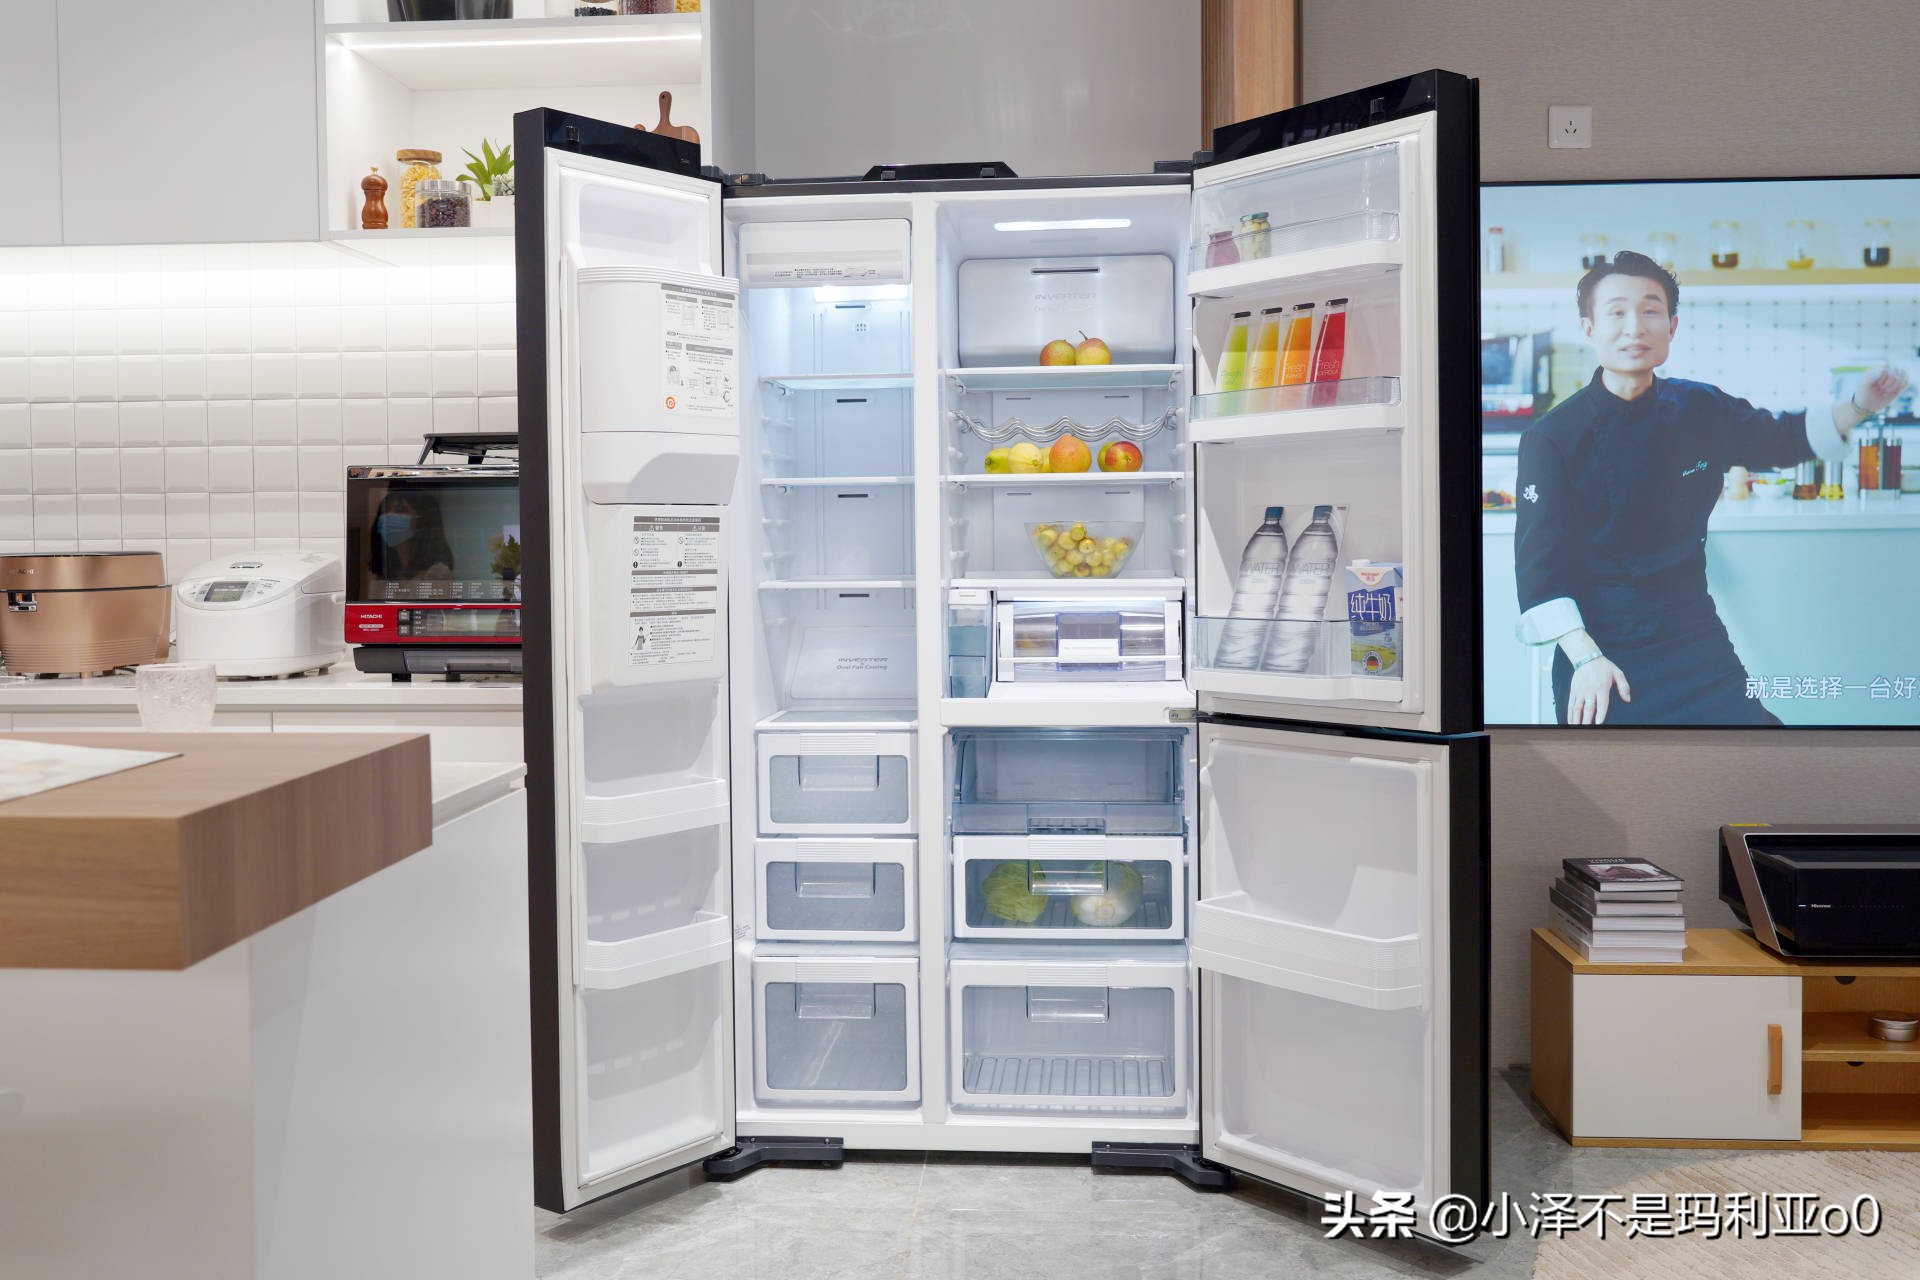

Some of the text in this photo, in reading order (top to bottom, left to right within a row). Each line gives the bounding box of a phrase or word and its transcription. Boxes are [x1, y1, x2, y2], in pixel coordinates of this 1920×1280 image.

[1351, 592, 1392, 623] 纯牛奶
[1745, 676, 1920, 700] 就是选择一台好
